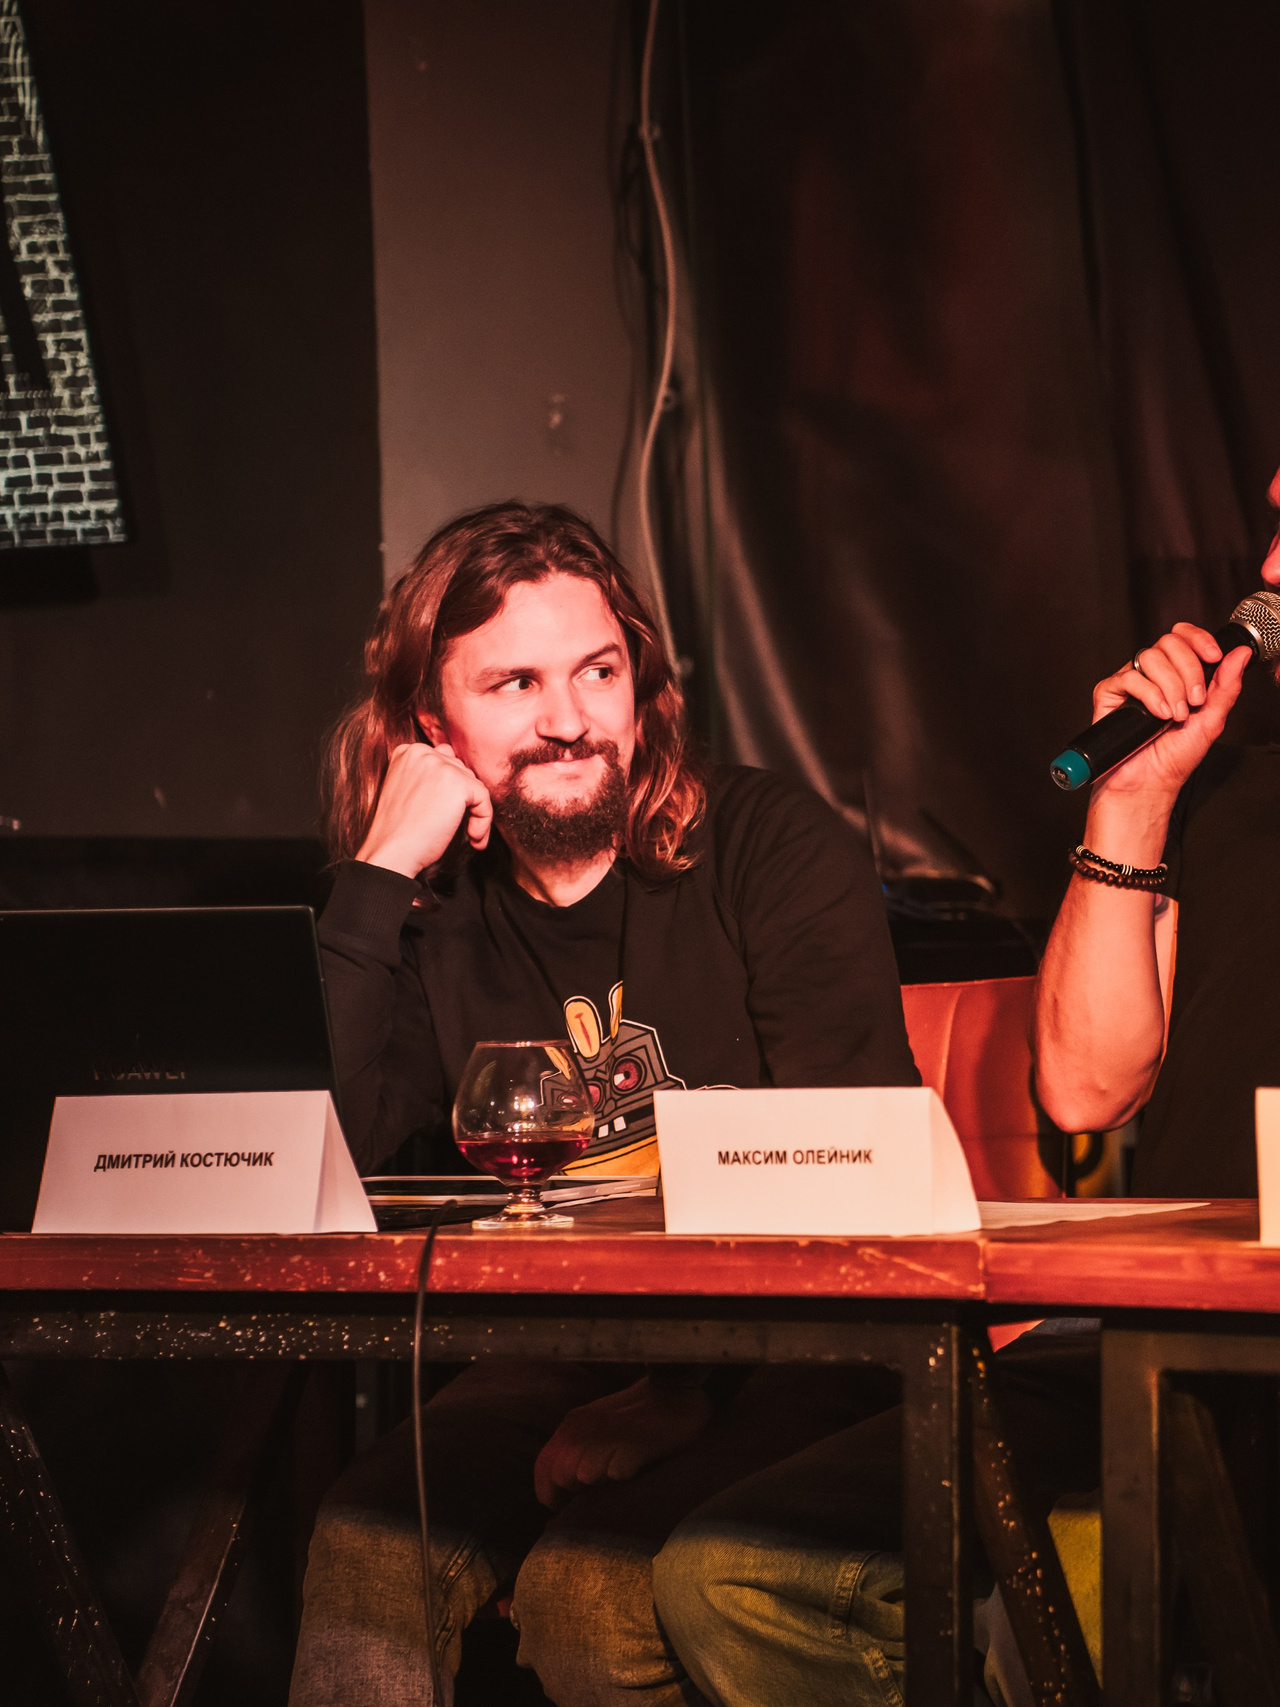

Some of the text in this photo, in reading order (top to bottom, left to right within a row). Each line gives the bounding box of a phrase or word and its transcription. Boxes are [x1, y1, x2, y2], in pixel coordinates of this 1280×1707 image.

[93, 1149, 275, 1173] ДМИТРИЙ КОСТЮЧИК
[717, 1146, 873, 1166] МАКСИМ ОЛЕЙНИК
